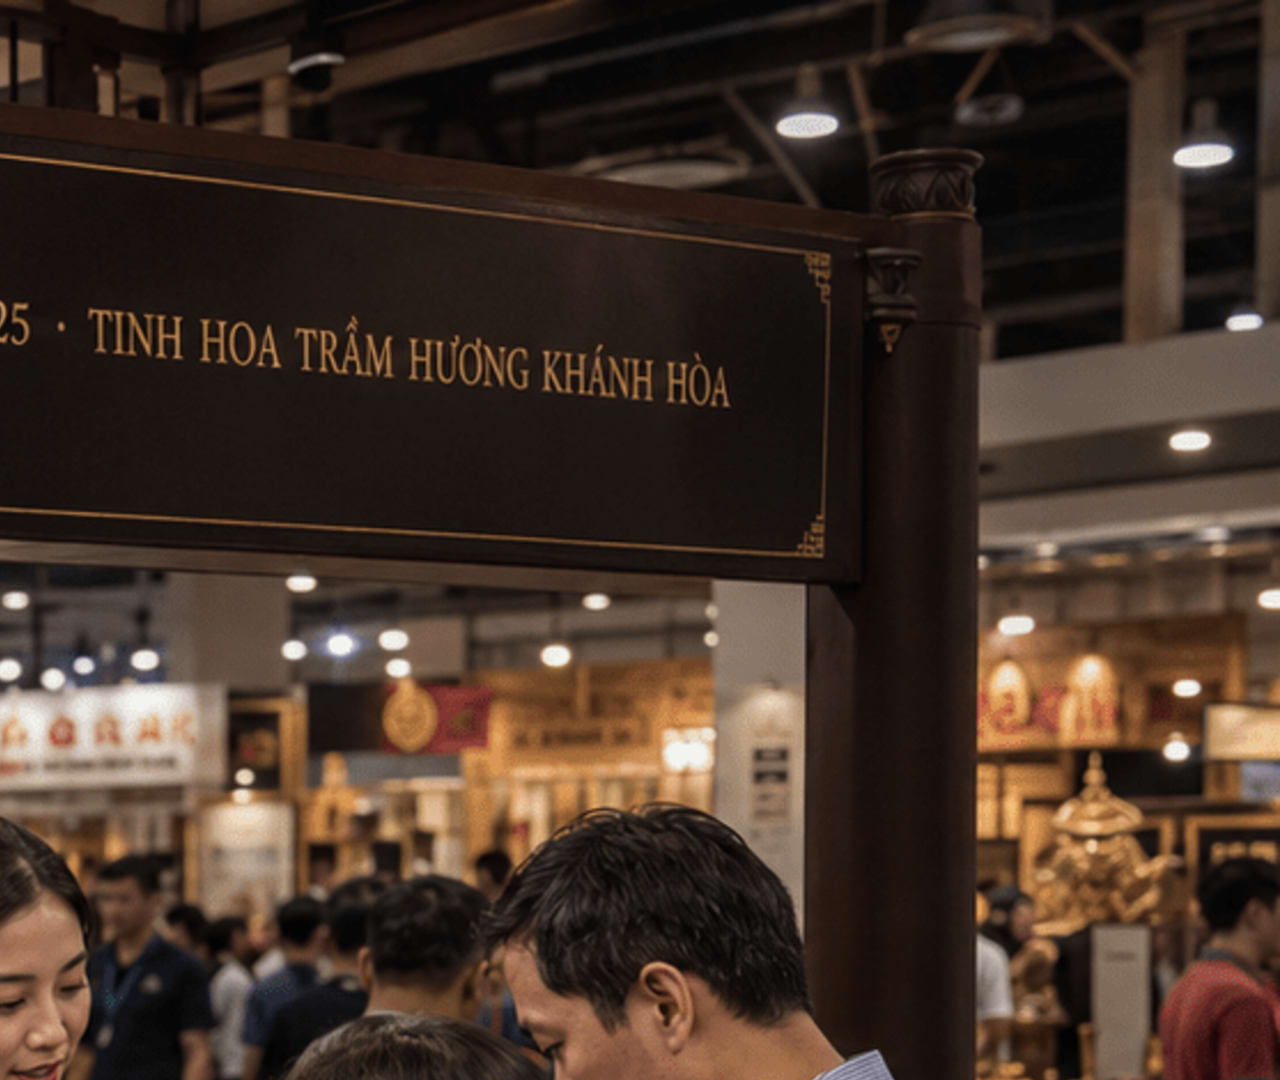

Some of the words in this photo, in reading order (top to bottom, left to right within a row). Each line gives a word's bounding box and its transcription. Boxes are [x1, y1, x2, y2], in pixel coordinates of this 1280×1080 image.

[87, 307, 184, 361] TINH
[199, 318, 282, 369] HOA
[294, 315, 395, 379] TRẦM
[408, 333, 530, 391] HƯƠNG
[541, 343, 654, 402] KHÁNH
[666, 351, 731, 408] HÒA
